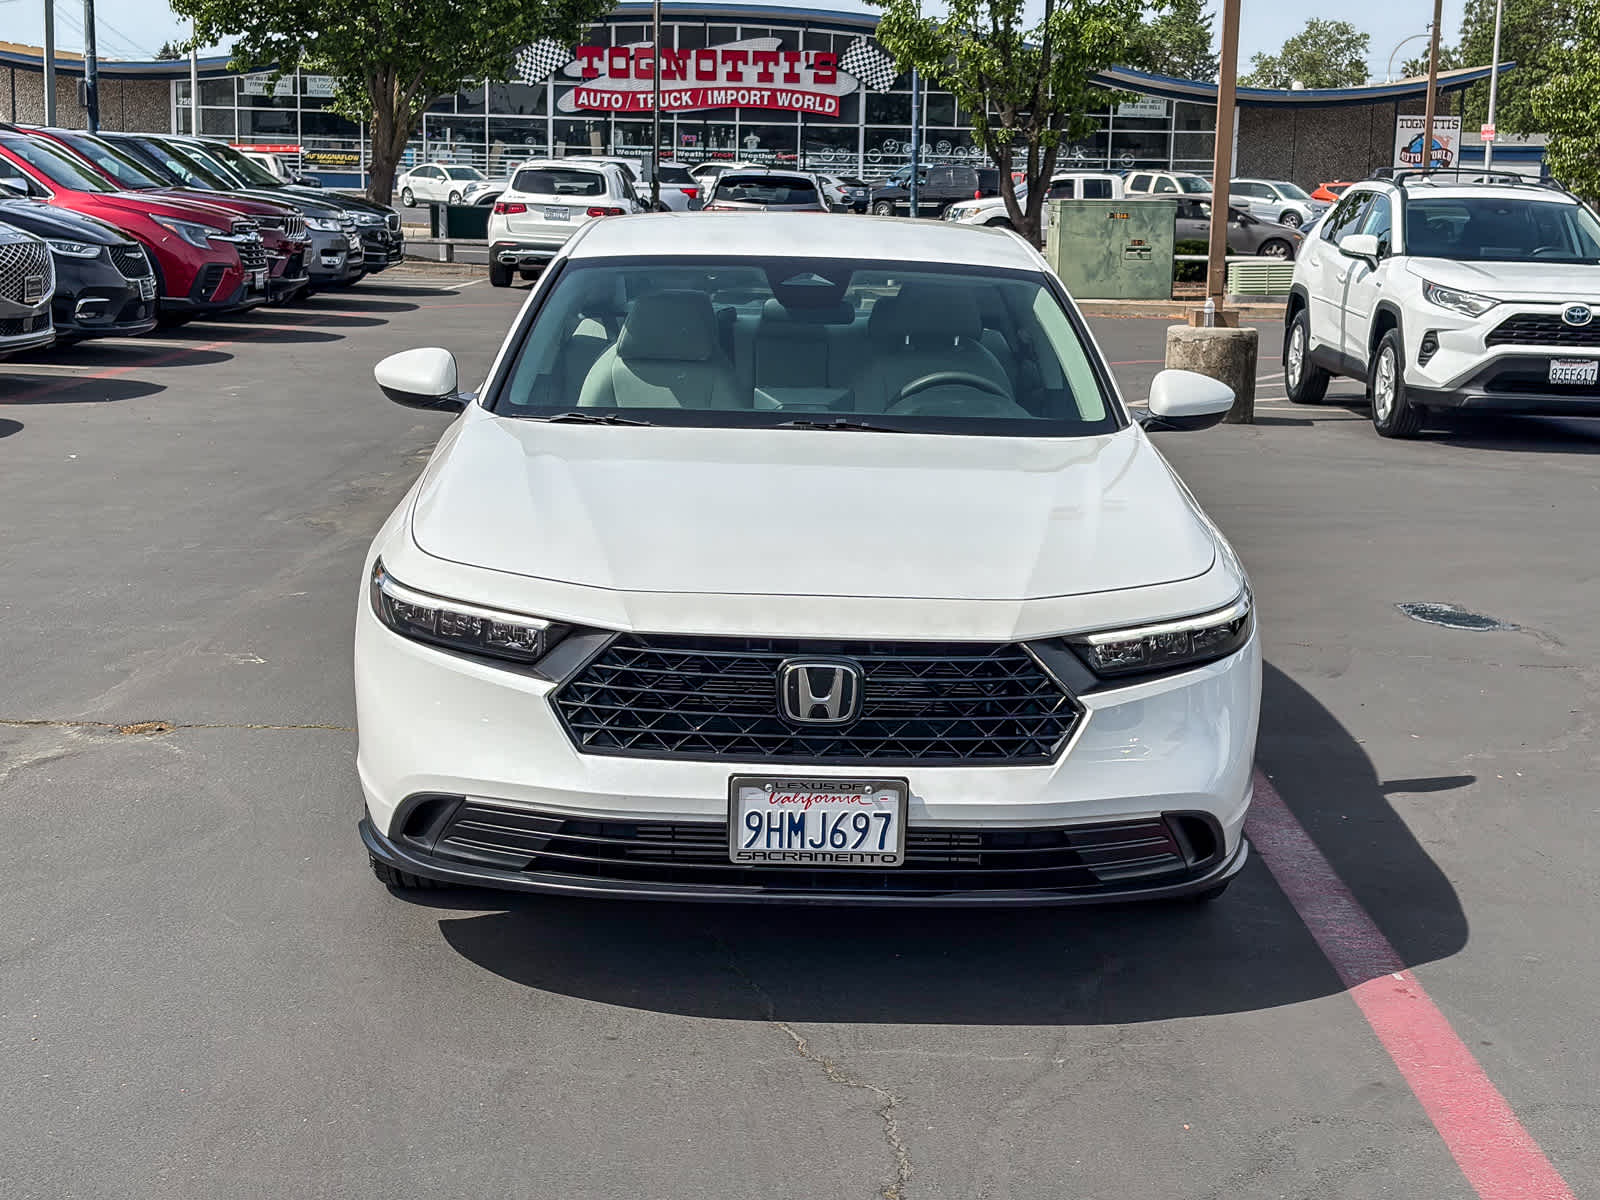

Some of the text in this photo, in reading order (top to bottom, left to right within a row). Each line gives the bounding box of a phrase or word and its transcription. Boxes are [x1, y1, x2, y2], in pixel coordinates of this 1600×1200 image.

[576, 46, 837, 84] TOGNOTTI'S
[578, 91, 623, 108] AUTO
[707, 90, 771, 106] IMPORT
[776, 92, 836, 113] WORLD
[1431, 150, 1452, 162] ORLD
[1552, 368, 1596, 381] 8ZEF617
[775, 781, 864, 791] LEXUS OF
[769, 792, 872, 811] California
[744, 811, 892, 850] 9HMJ697
[736, 851, 897, 863] SACRAMENTO
